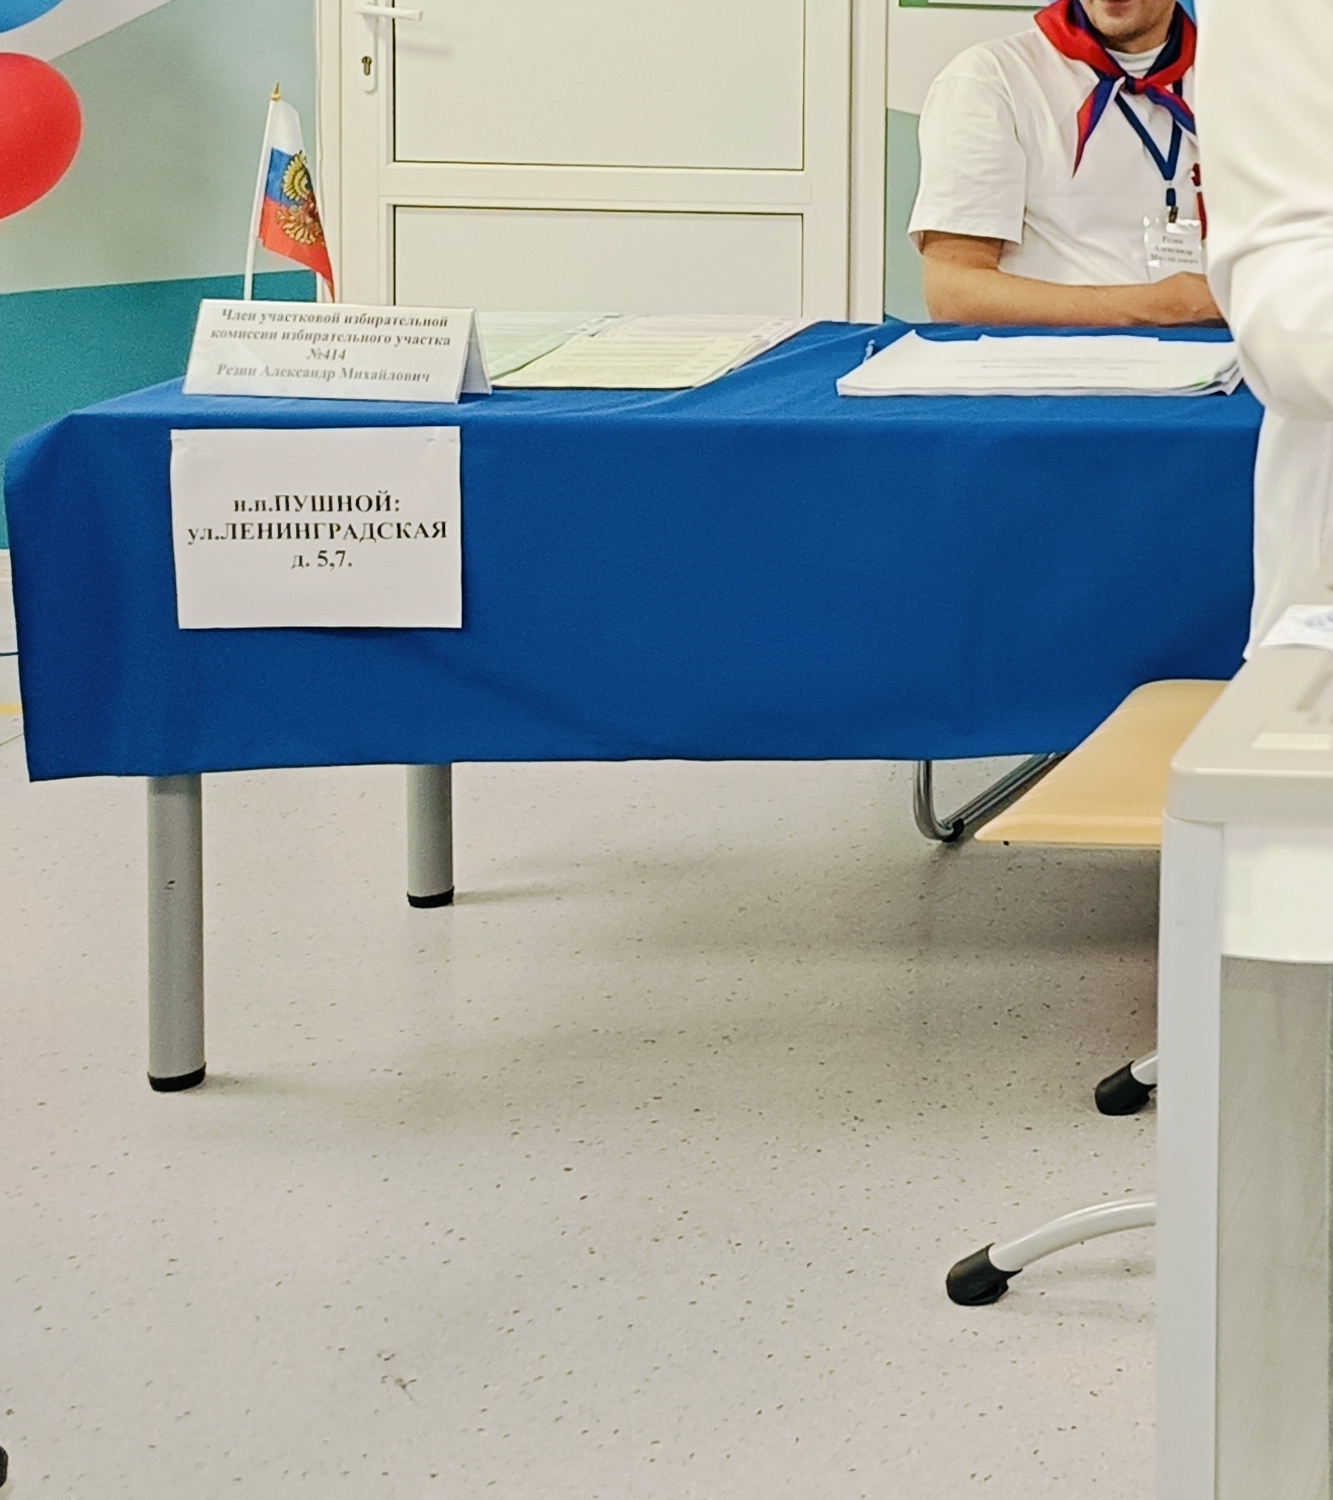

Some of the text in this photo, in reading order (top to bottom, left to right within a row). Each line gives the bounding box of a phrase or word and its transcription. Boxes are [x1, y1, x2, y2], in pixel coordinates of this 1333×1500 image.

[222, 308, 449, 328] Член участковой избирательной
[210, 329, 451, 348] комиссии избирательного участка
[260, 364, 336, 382] Александр
[339, 367, 430, 383] Михайлович
[233, 490, 401, 513] н.п.ПУШНОЙ:
[187, 520, 447, 546] ул.ЛЕНИНГРАДСКАЯ
[291, 550, 353, 571] д. 5,7.
